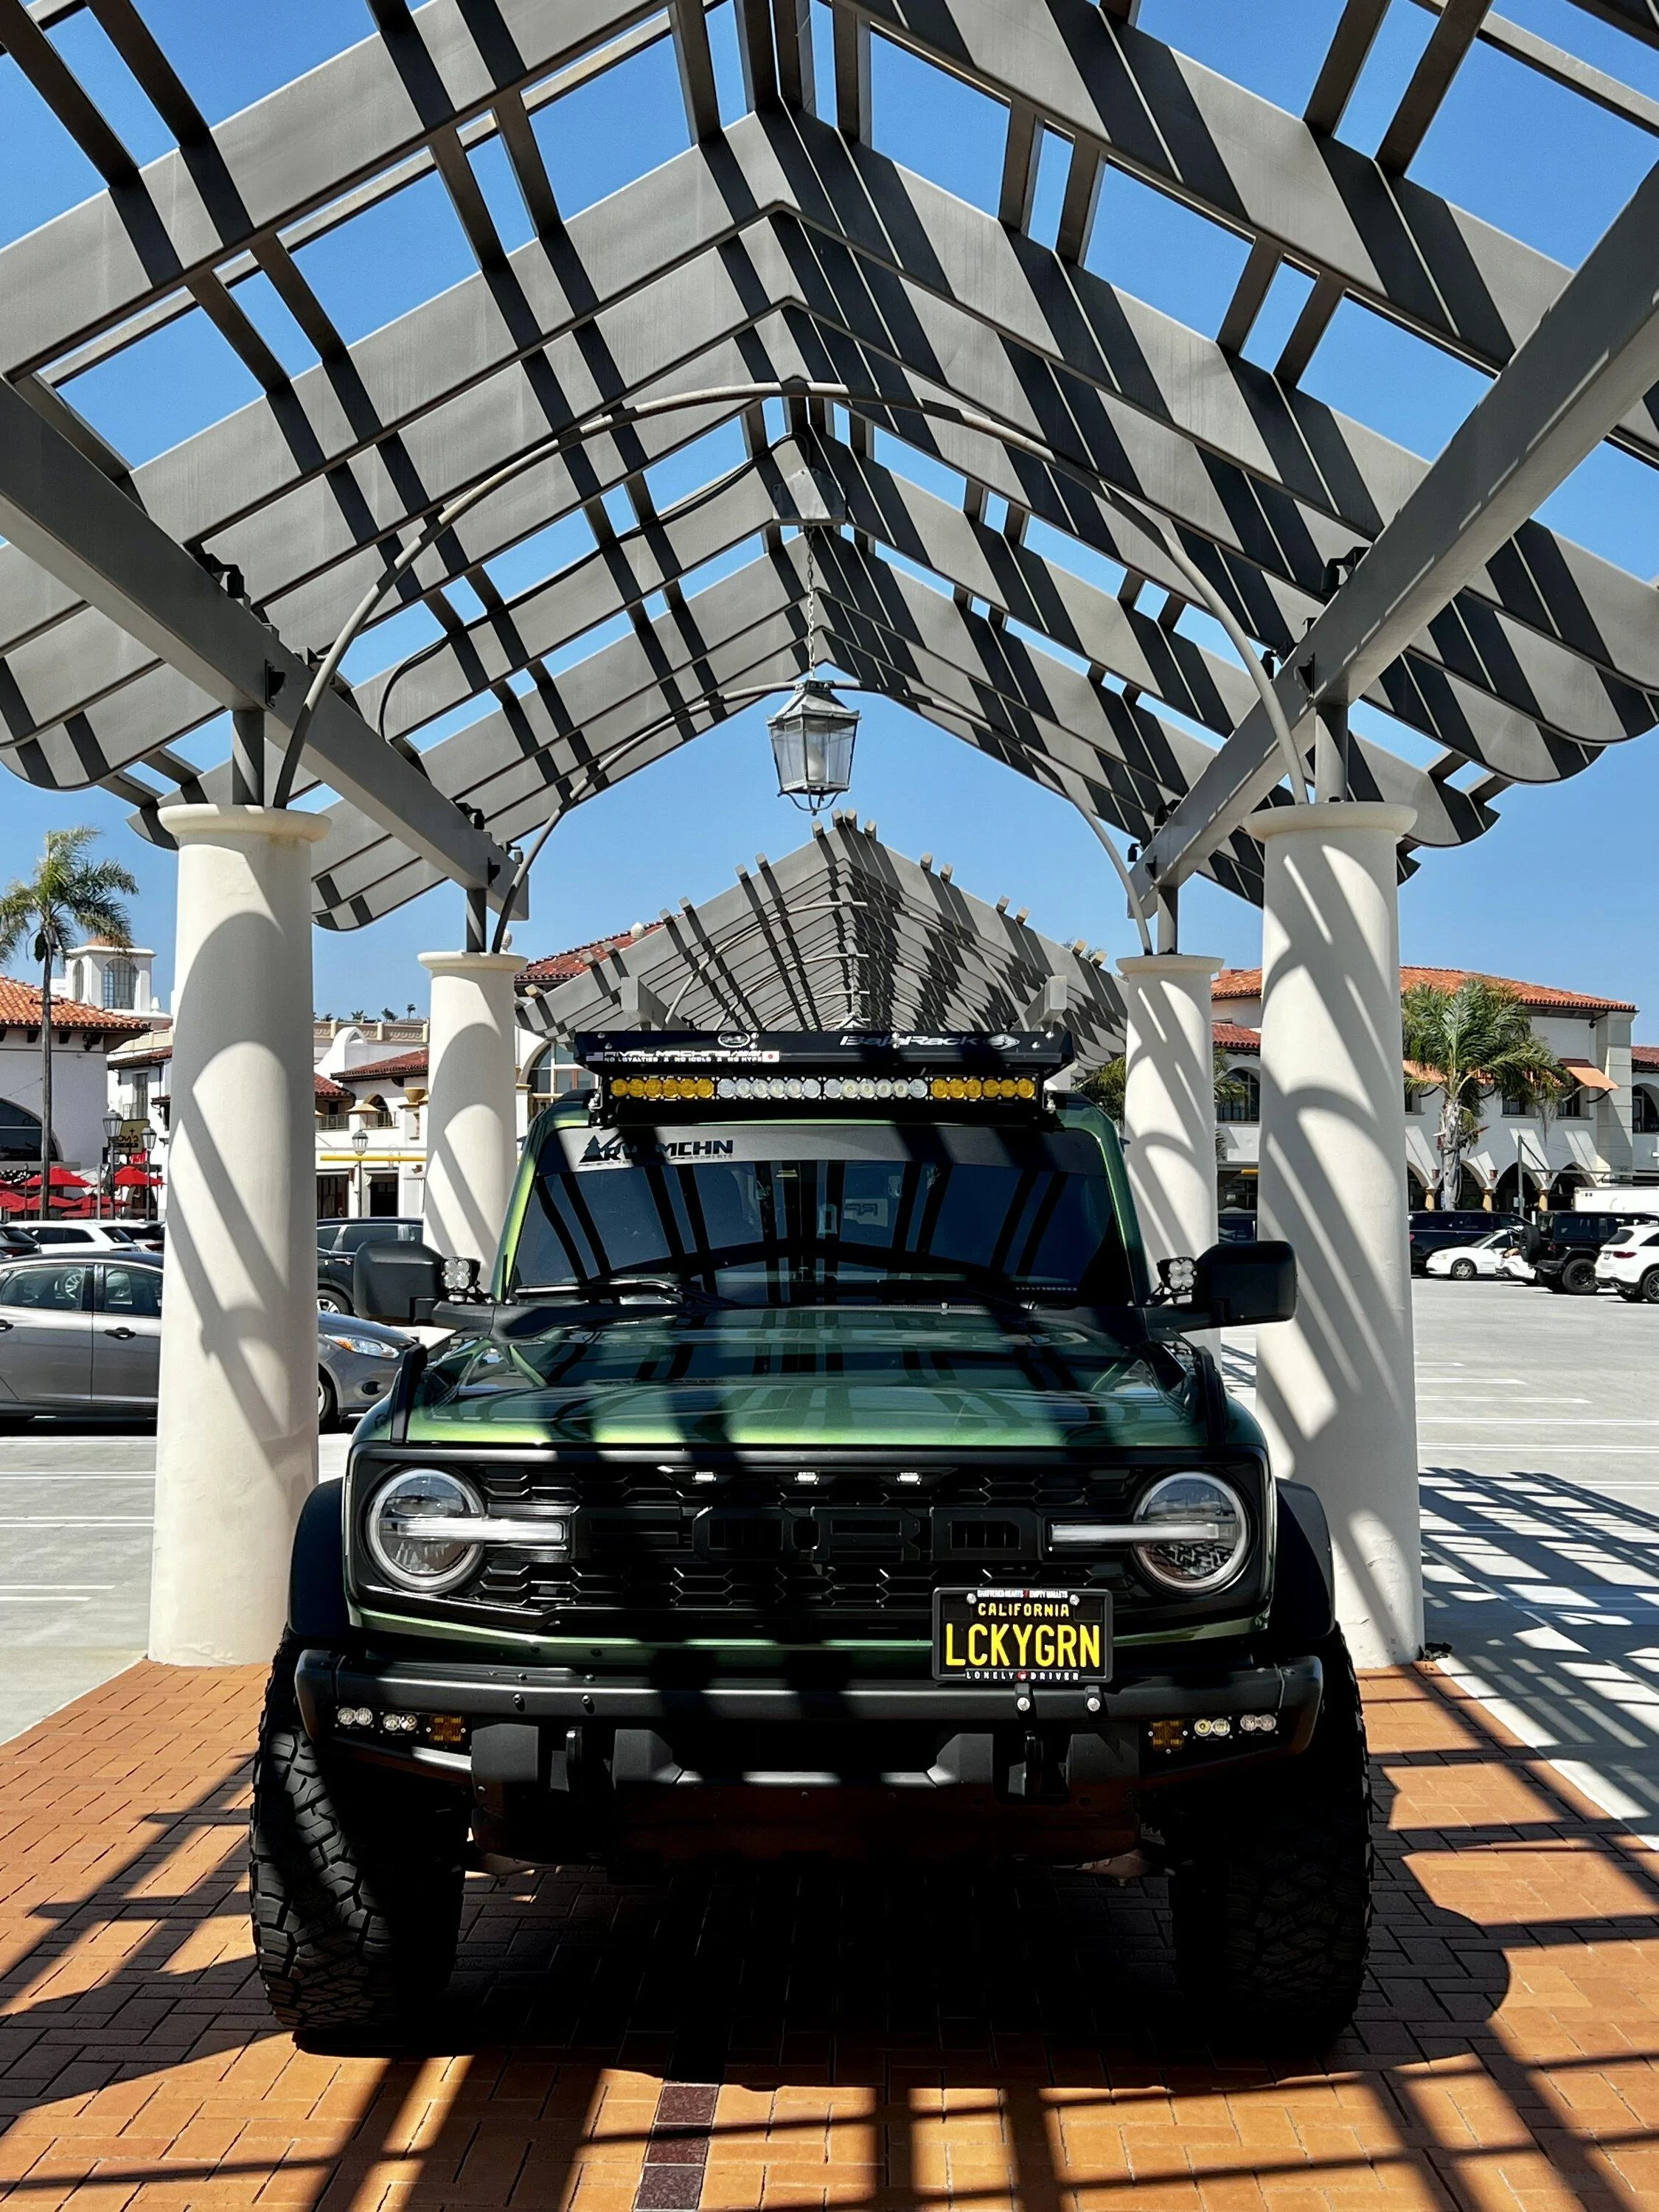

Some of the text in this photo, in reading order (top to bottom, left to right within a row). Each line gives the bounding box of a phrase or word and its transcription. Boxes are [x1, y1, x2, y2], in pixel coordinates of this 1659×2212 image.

[978, 1602, 1070, 1617] CALIFORNIA
[946, 1623, 1100, 1668] LCKYGRN
[966, 1671, 1079, 1681] LONELY DRIVER
